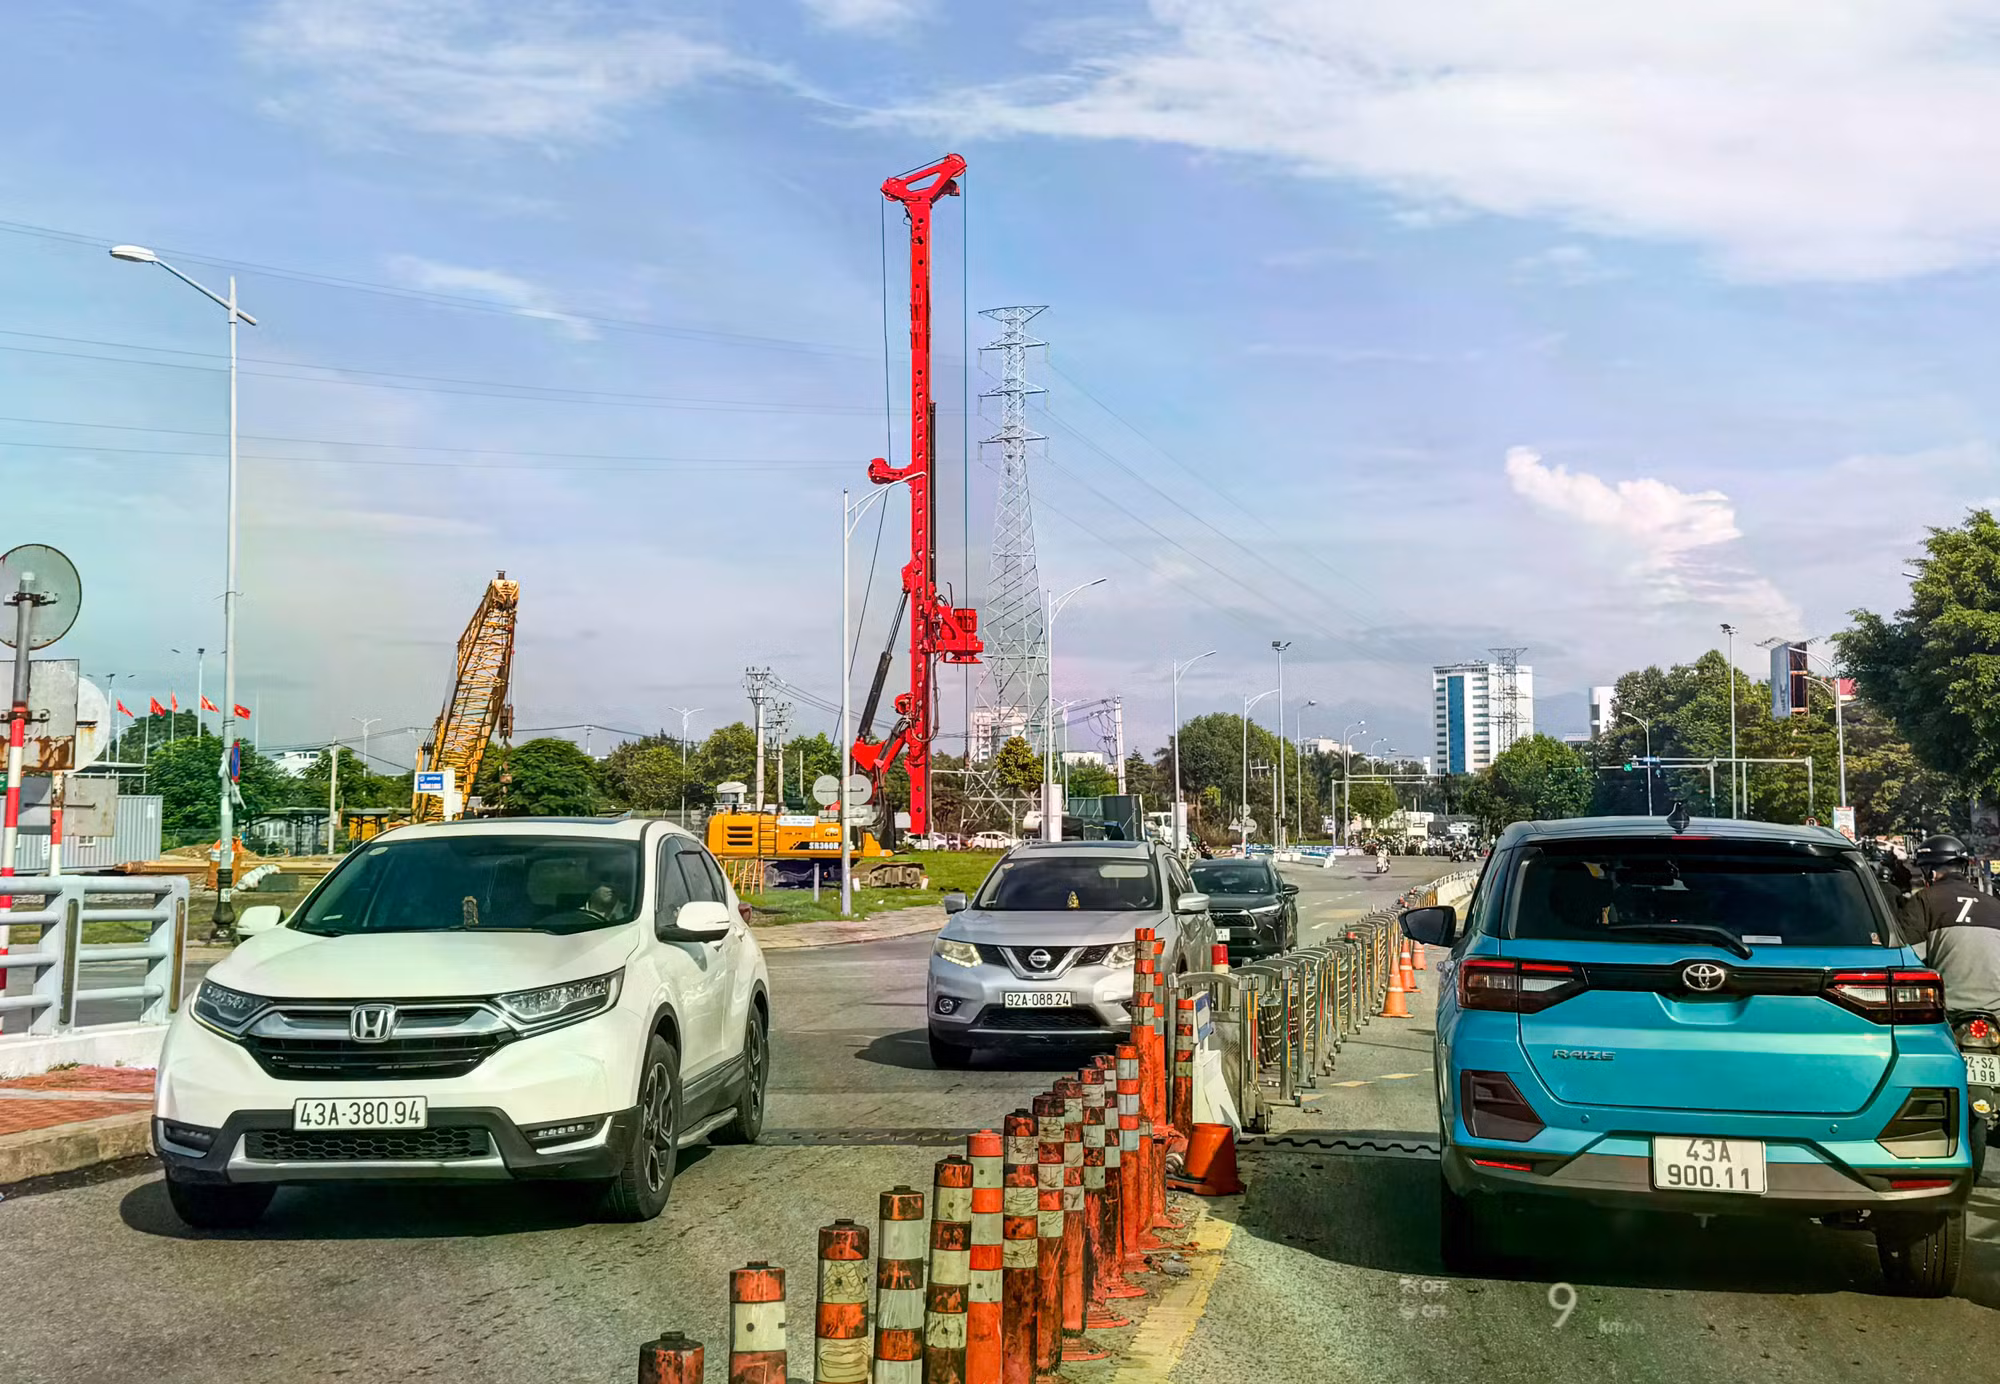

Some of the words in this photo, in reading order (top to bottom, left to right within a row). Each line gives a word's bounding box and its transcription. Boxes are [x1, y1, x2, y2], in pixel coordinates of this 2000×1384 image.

[1007, 993, 1069, 1006] 92A-088.24
[1963, 1056, 1995, 1069] 2-S2
[300, 1100, 421, 1126] 43A-380.94
[1686, 1139, 1732, 1163] 43A
[1667, 1164, 1750, 1190] 900.11
[1421, 1280, 1450, 1293] OFF
[1549, 1282, 1577, 1328] 9
